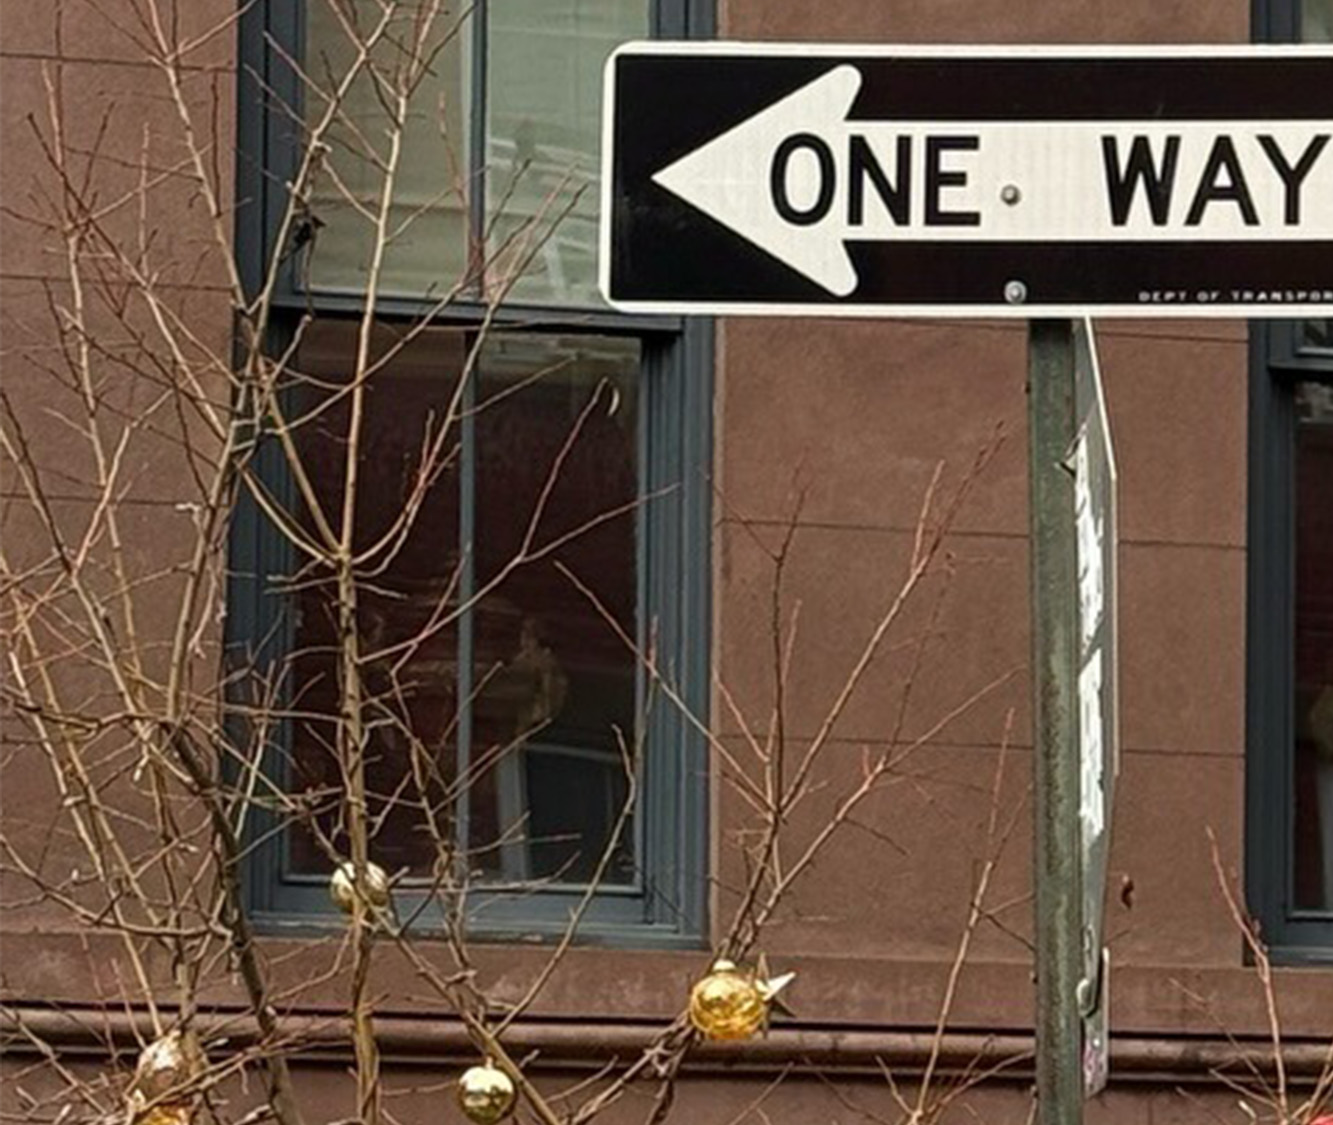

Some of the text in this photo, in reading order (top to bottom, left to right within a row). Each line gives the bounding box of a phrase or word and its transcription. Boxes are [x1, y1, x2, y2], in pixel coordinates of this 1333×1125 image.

[769, 131, 1332, 227] ONE WAY
[1138, 290, 1187, 302] DEPT
[1196, 290, 1220, 302] OF
